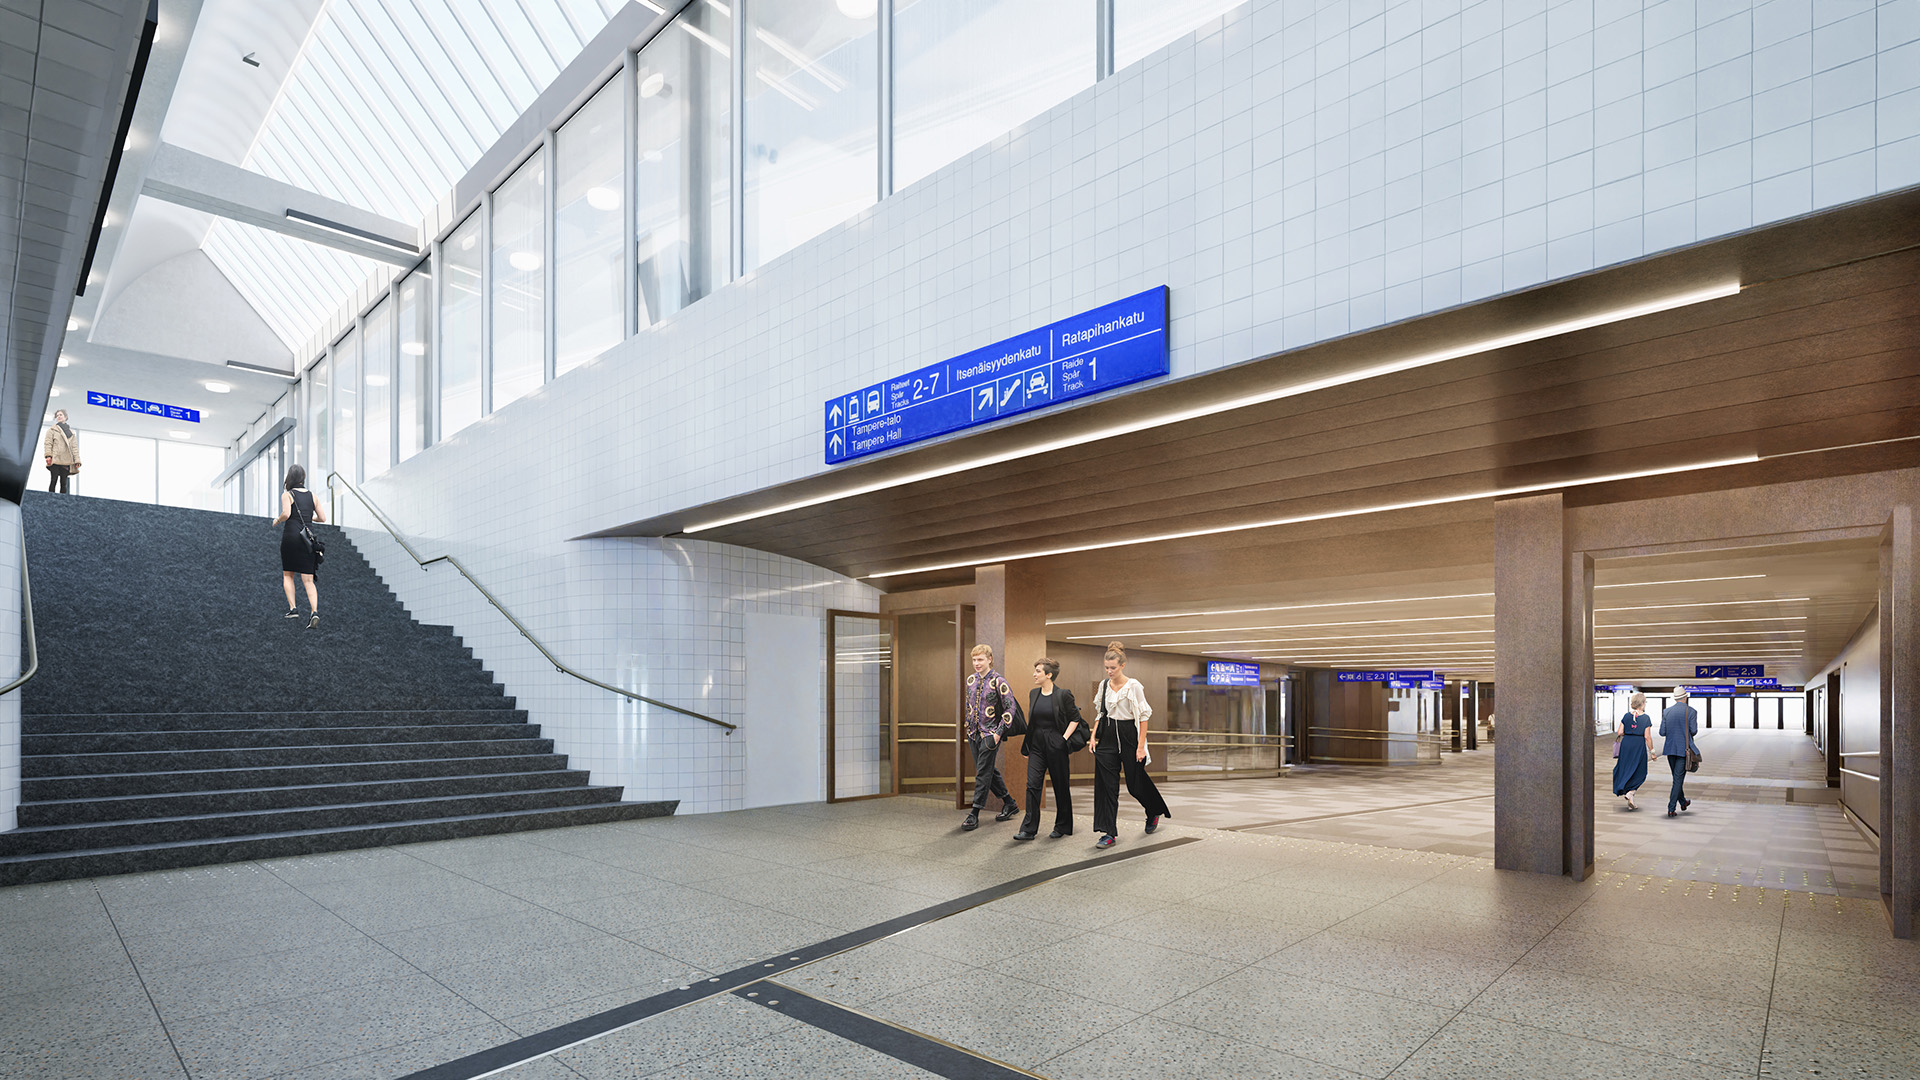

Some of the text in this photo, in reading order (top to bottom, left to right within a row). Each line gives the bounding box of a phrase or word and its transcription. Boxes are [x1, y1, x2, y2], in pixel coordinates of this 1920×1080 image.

[1062, 311, 1145, 347] Ratapihankatu
[956, 344, 1042, 381] Itsenäisyydenkatu
[1062, 357, 1084, 370] Raide
[1088, 356, 1097, 381] 1
[913, 372, 940, 401] 2-7
[1063, 380, 1084, 392] Track
[185, 411, 191, 419] 1
[891, 398, 910, 410] Tracks
[851, 414, 902, 436] Tampere-talo
[851, 428, 902, 452] Tampere Hall
